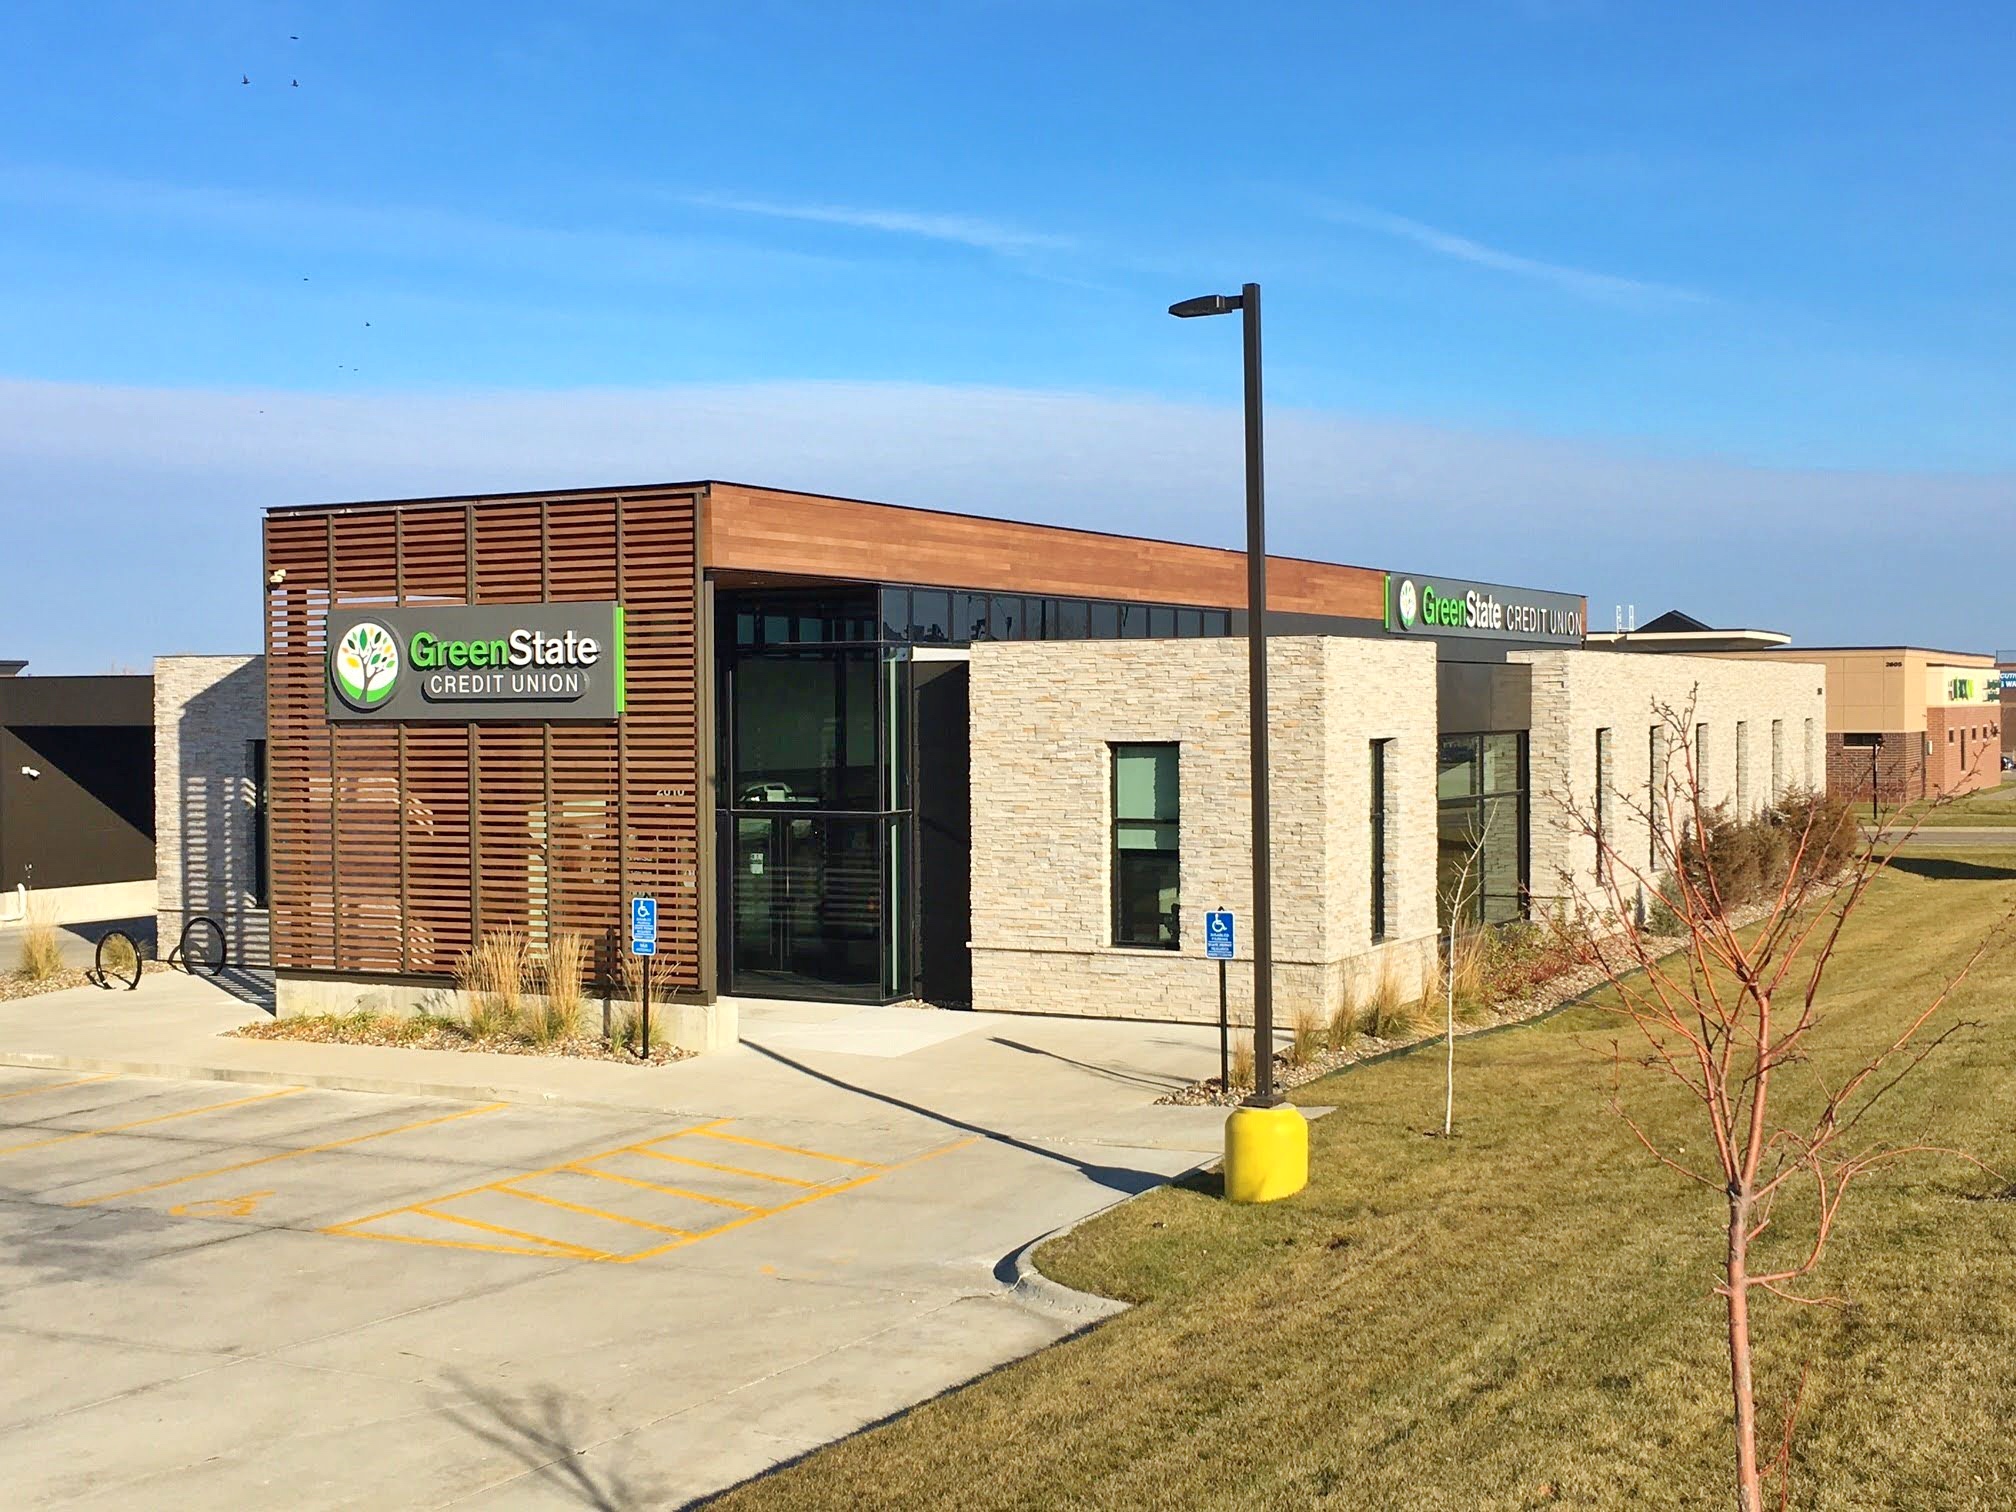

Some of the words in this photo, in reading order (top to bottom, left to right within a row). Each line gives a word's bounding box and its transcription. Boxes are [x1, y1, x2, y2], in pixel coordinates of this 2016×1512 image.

[1423, 586, 1501, 629] GreenState
[1506, 604, 1547, 631] CREDIT
[1550, 610, 1582, 635] UNION
[410, 629, 599, 667] GreenState
[430, 673, 504, 694] CREDIT
[512, 673, 579, 693] UNION
